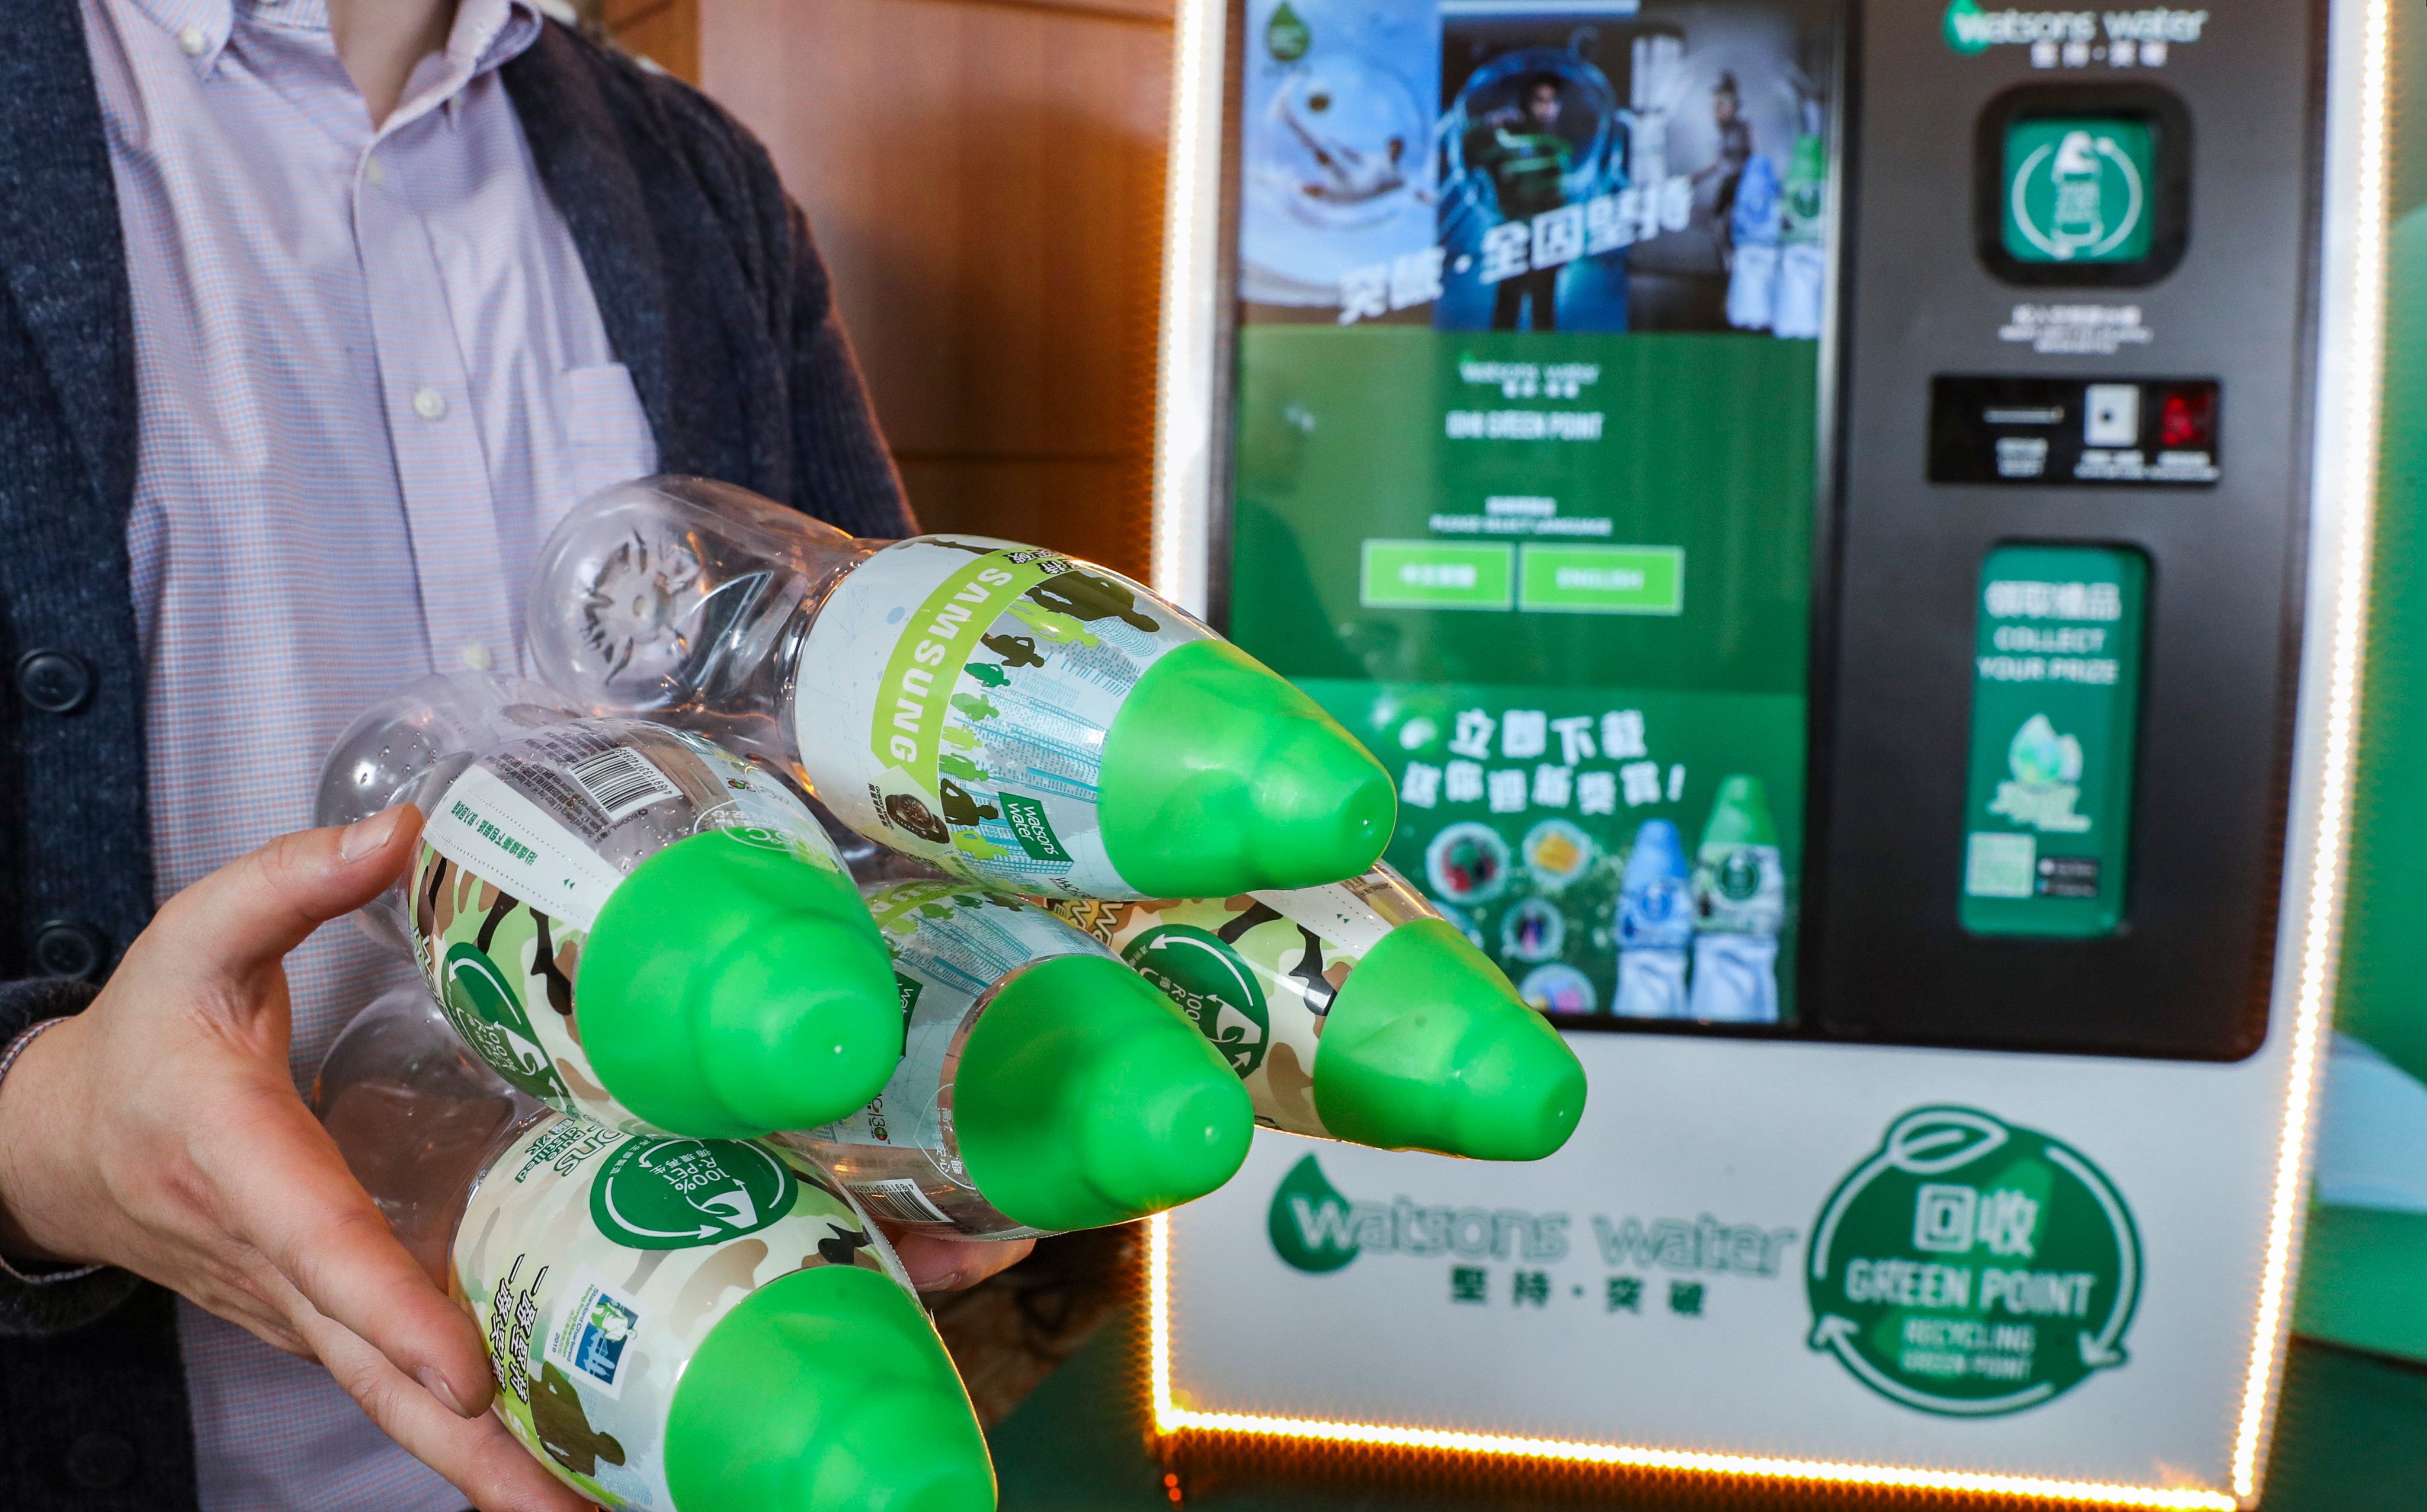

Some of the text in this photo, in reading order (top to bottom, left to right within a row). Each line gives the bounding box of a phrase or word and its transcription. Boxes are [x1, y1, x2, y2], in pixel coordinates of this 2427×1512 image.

[890, 567, 1013, 763] SAMSUNG
[514, 1127, 578, 1184] distilled
[649, 1148, 712, 1175] 循環再生
[675, 1167, 731, 1194] 100%
[1912, 1182, 2039, 1258] 回收
[581, 1283, 594, 1302] Hong
[1844, 1257, 2098, 1318] GREEN POINT
[552, 1332, 561, 1353] 2019
[566, 1287, 599, 1362] Standard Chartered
